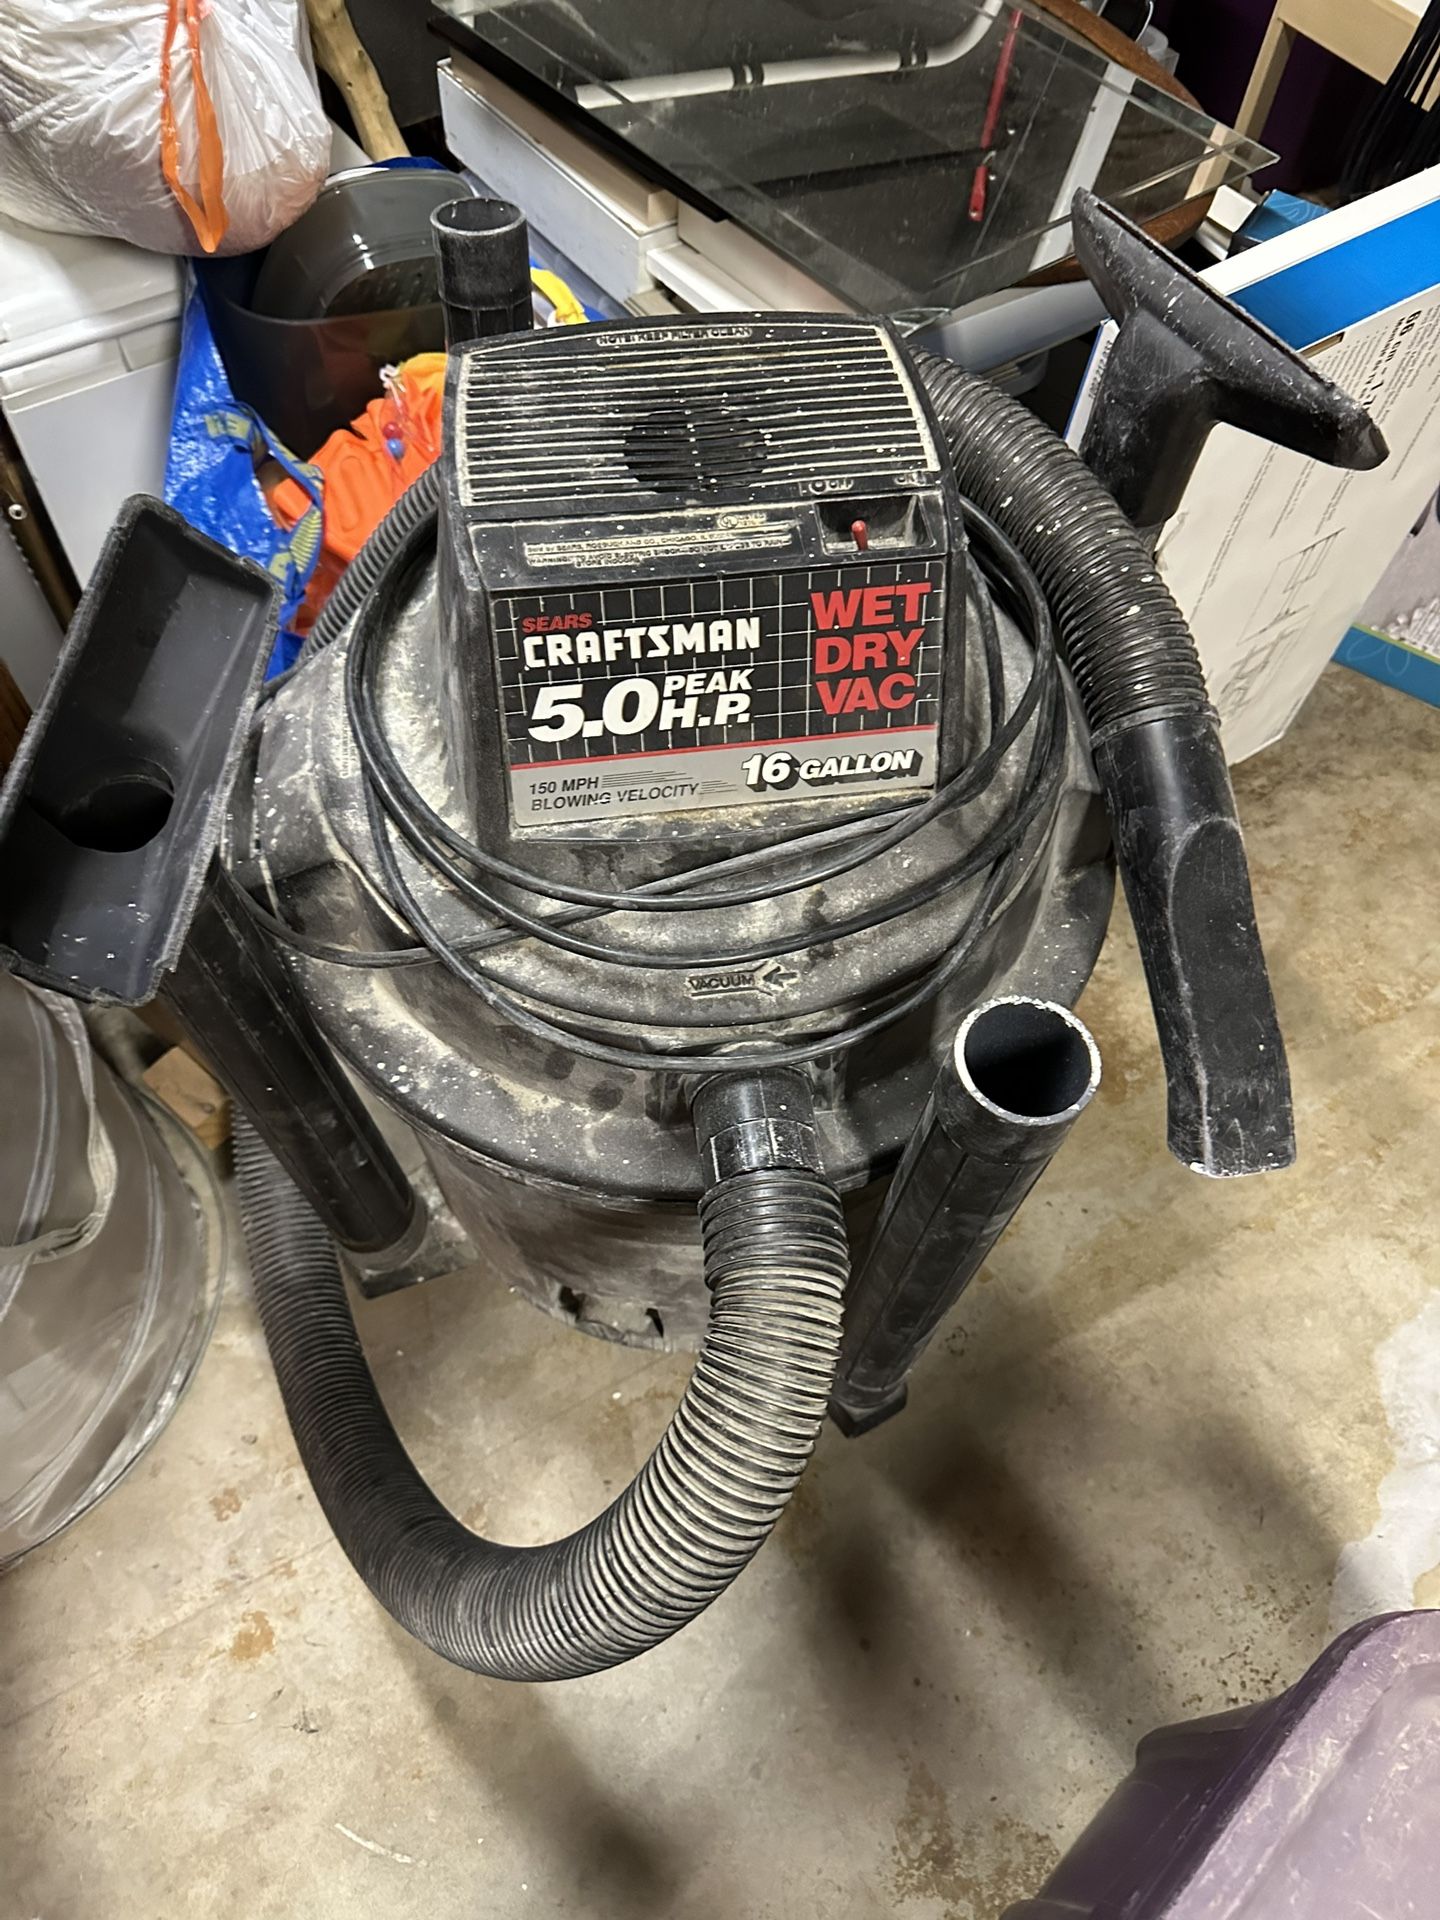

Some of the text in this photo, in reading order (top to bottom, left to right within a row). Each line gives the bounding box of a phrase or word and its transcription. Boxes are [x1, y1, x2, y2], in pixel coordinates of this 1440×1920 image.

[712, 326, 750, 337] CLEAN
[522, 612, 592, 632] SEARS
[811, 582, 931, 630] WET
[523, 617, 760, 669] CRAFTSMAN
[815, 628, 925, 674] DRY
[663, 669, 755, 698] PEAK
[816, 672, 915, 714] VAC
[528, 678, 659, 742] 5.0
[659, 693, 751, 731] H.P.
[529, 776, 599, 795] 150 MPH
[741, 749, 919, 788] 16 GALLON
[531, 783, 699, 811] BLOWING VELOCITY
[688, 973, 757, 990] VACUUM
